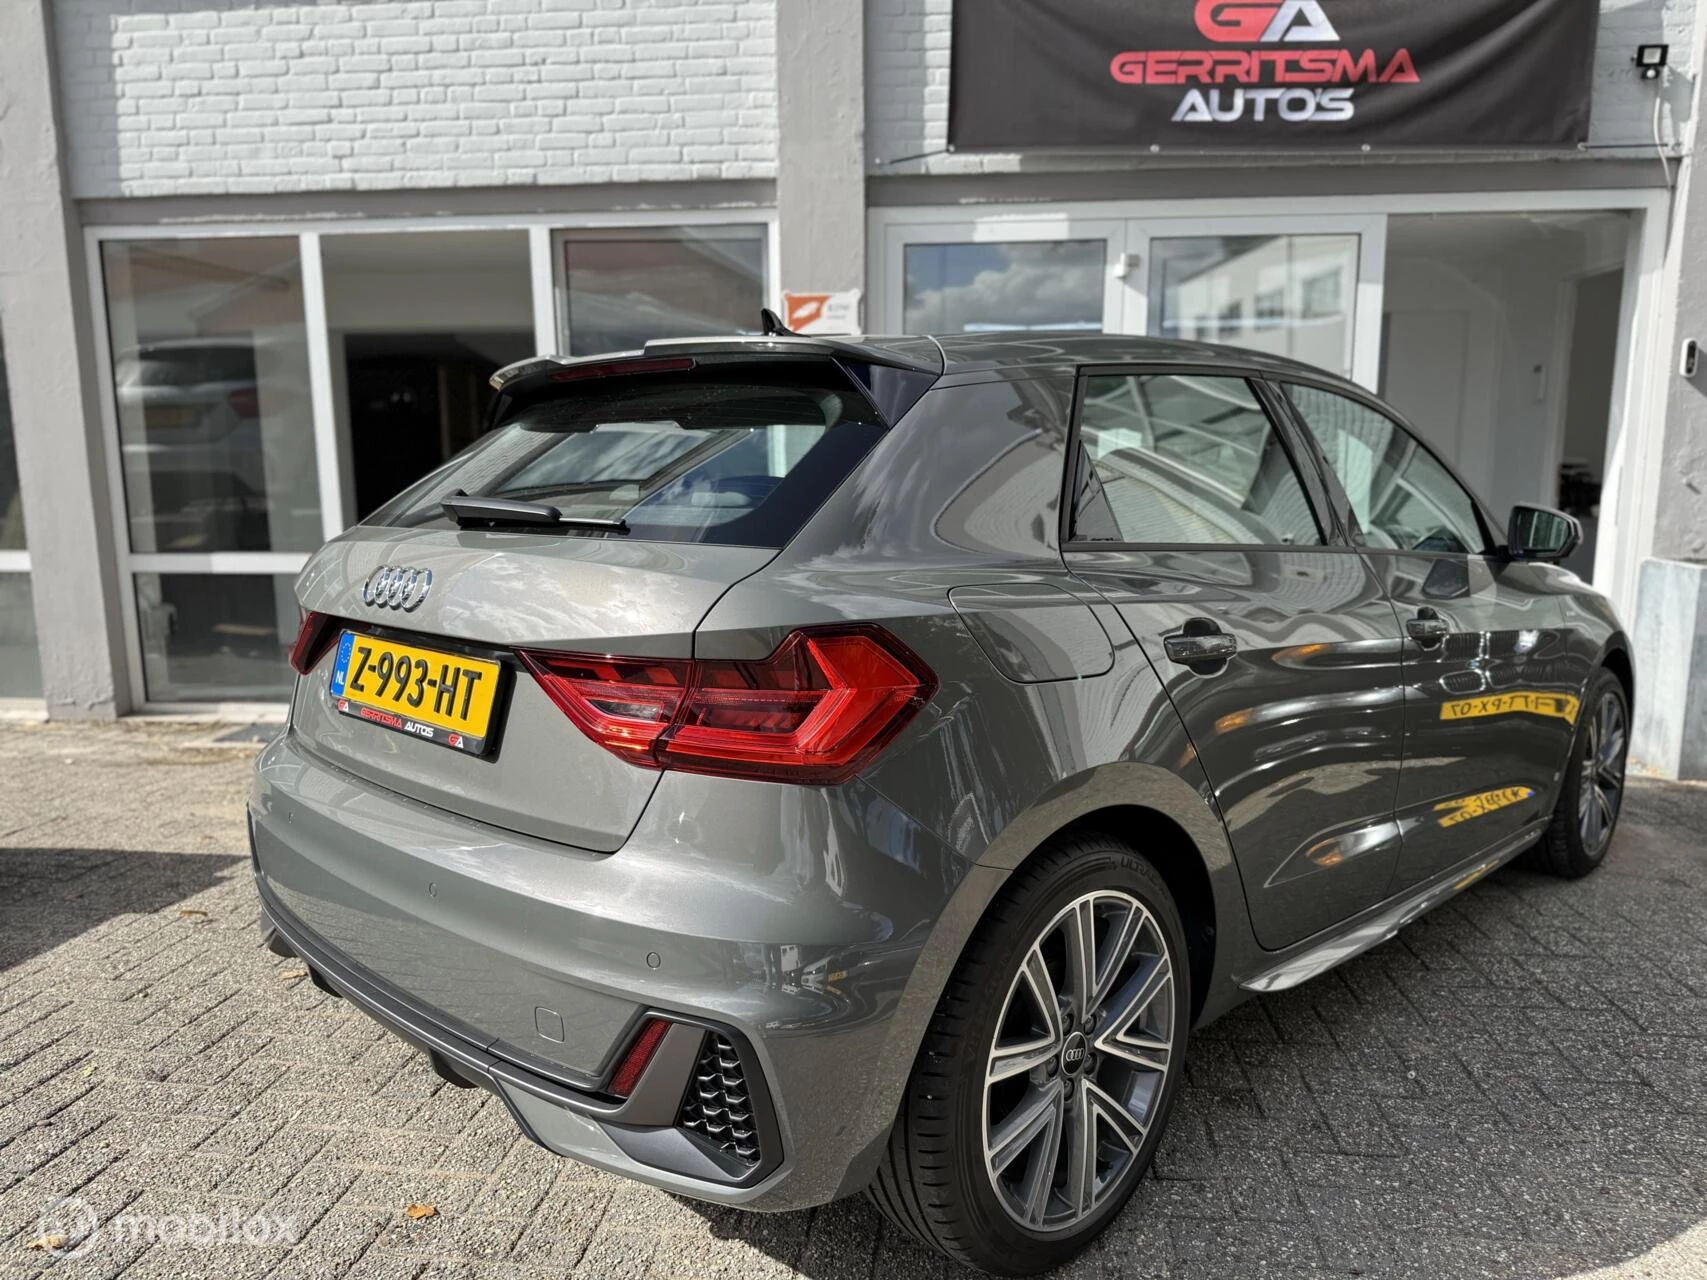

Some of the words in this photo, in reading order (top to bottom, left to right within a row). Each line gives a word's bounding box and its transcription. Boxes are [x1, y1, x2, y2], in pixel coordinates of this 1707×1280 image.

[1194, 0, 1341, 42] GA
[1109, 48, 1421, 84] GERRITSMA
[1171, 88, 1355, 122] AUTO'S
[335, 670, 345, 685] NL
[349, 646, 483, 721] Z-993-HT
